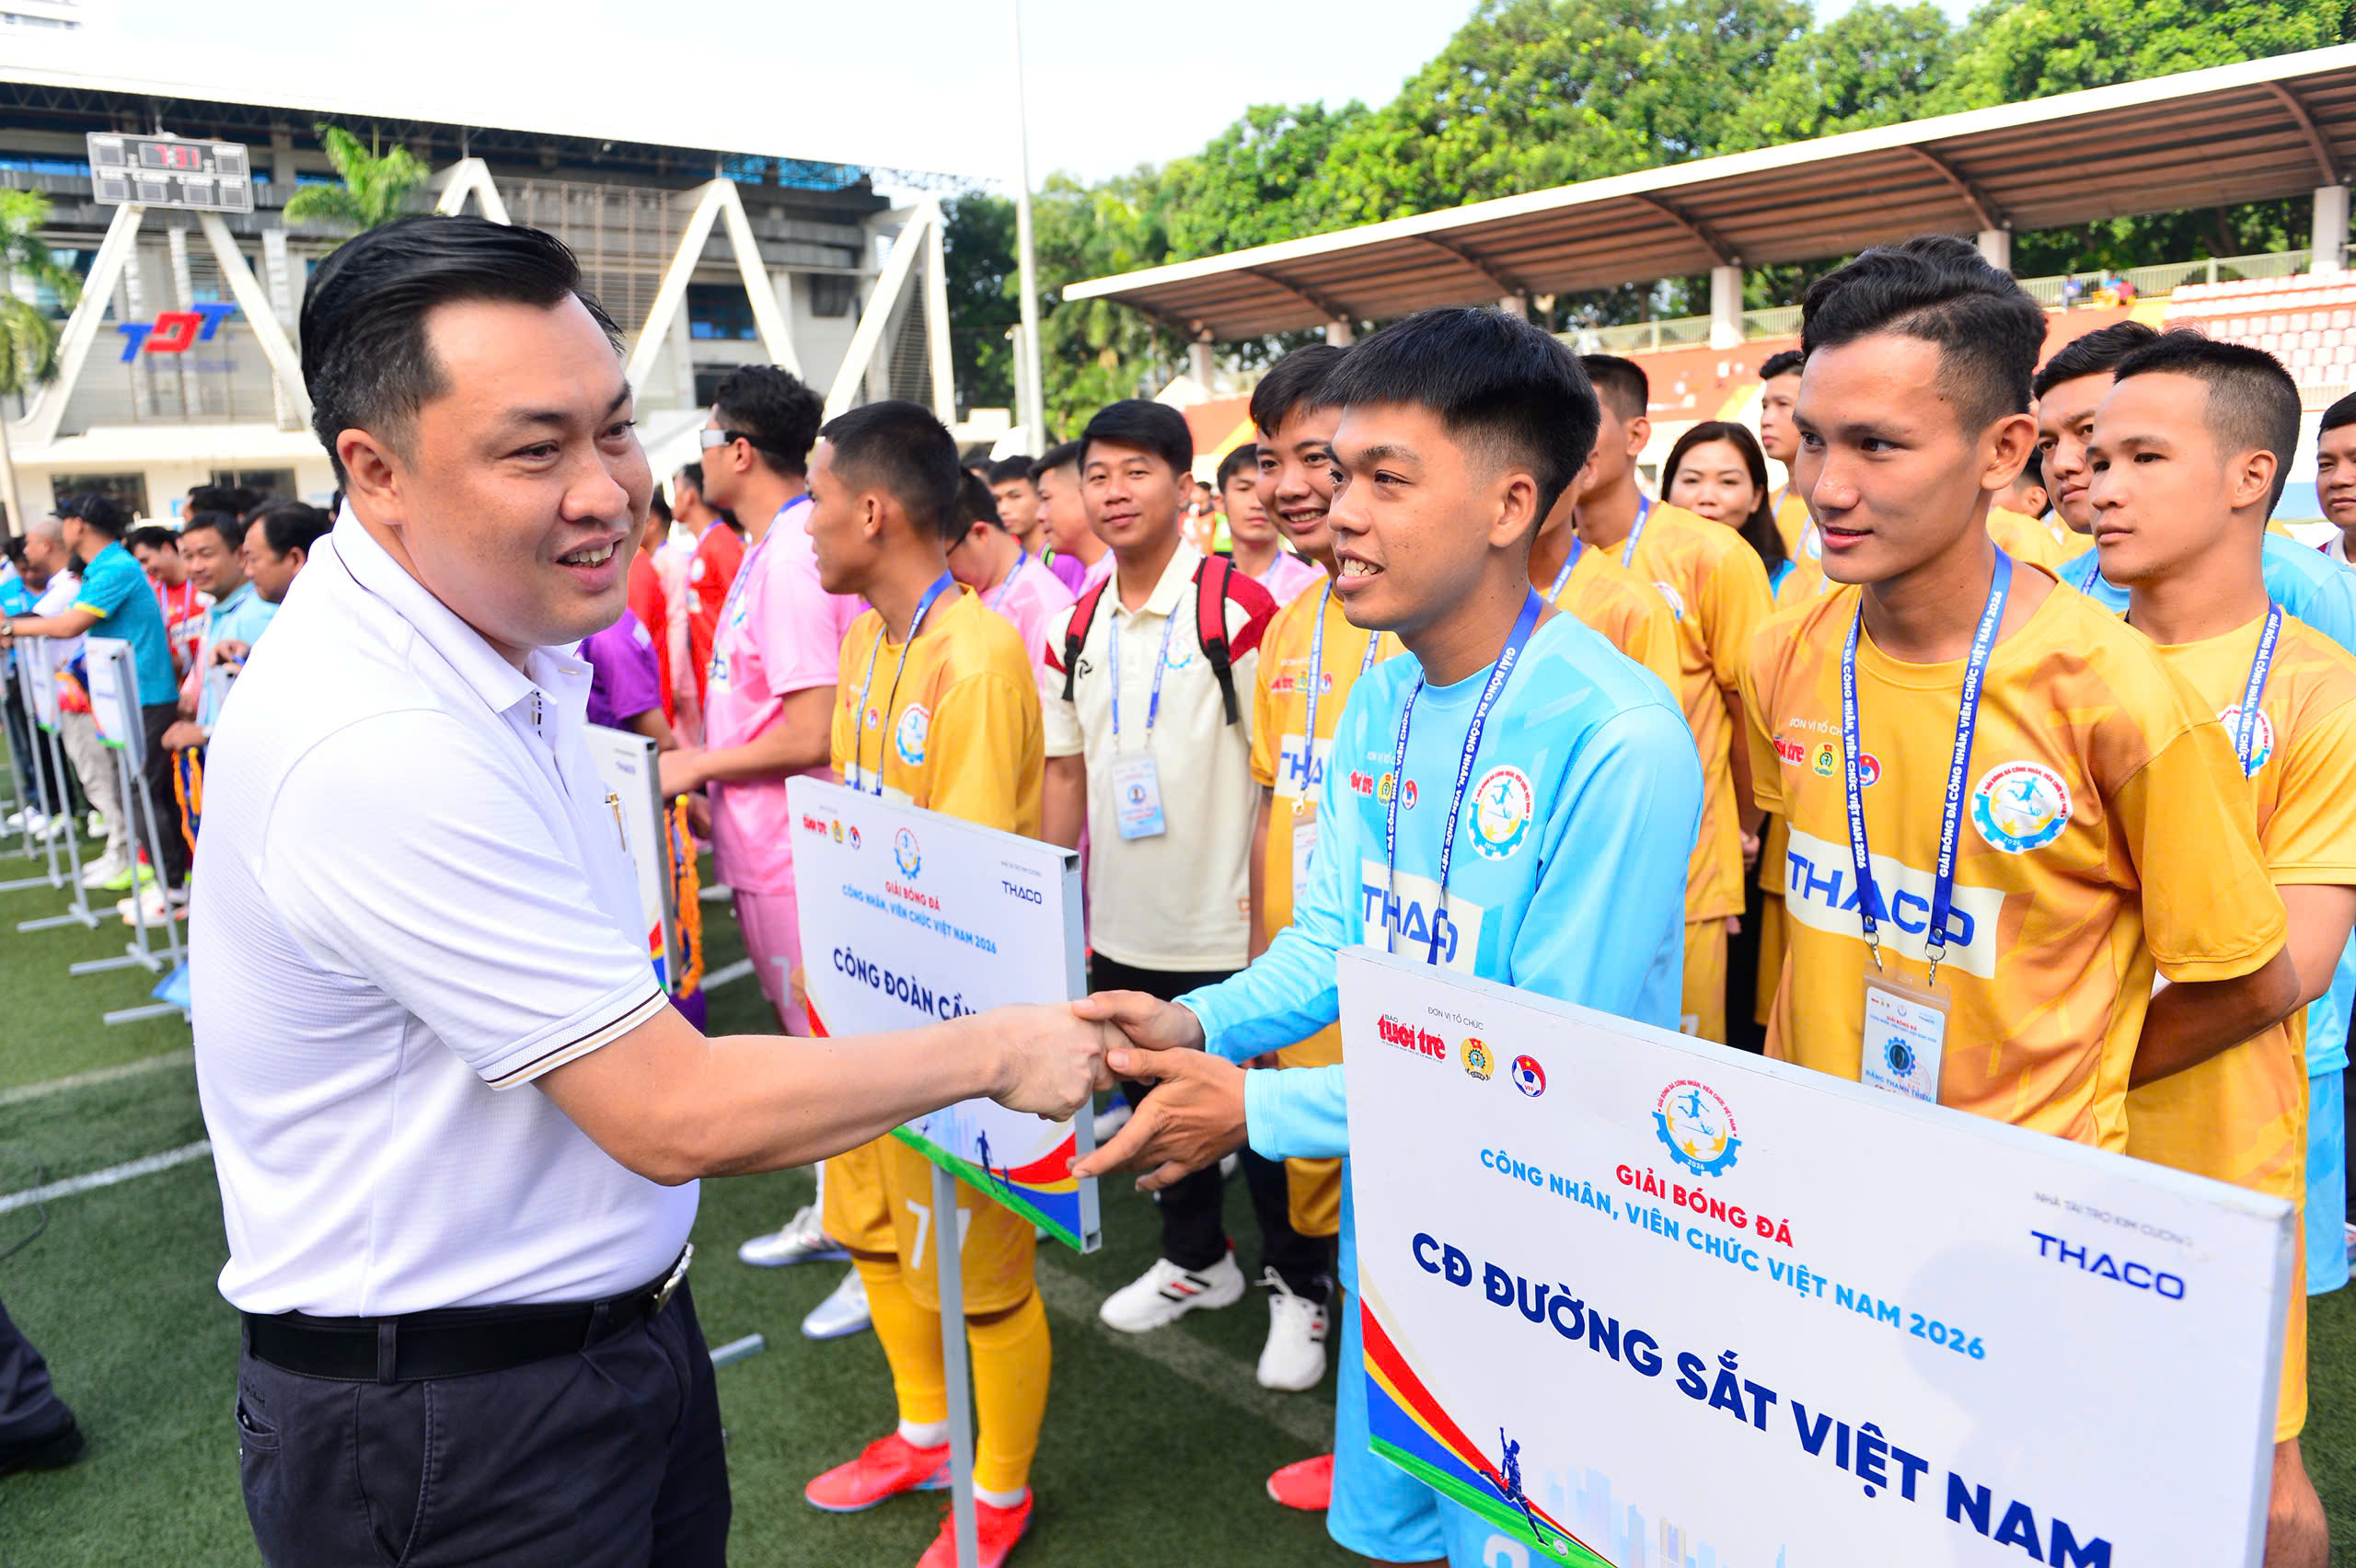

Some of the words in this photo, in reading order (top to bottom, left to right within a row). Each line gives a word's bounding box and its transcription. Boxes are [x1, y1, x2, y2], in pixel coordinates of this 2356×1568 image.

[1986, 590, 2004, 618] 2026
[1978, 617, 1994, 644] NAM
[1970, 641, 1987, 668] VIỆT
[1484, 670, 1506, 702] BÓNG
[1842, 665, 1854, 698] CÔNG
[1964, 667, 1981, 702] CHỨC
[1959, 702, 1973, 728] VIÊN
[1465, 719, 1481, 753] CÔNG
[1845, 733, 1858, 759] VIÊN
[1847, 760, 1859, 792] CHỨC
[1947, 766, 1963, 801] CÔNG
[1848, 792, 1862, 817] VIỆT
[1852, 816, 1865, 843] NAM
[1942, 820, 1956, 853] BÓNG
[1854, 842, 1867, 869] 2026
[1938, 854, 1950, 878] GIẢI
[1001, 881, 1043, 905] THACO
[953, 927, 973, 946] NAM
[834, 947, 880, 989] CÔNG
[884, 970, 933, 1016] ĐOÀN
[1615, 1163, 1666, 1200] GIẢI
[1672, 1187, 1748, 1230] BÓNG
[1755, 1213, 1795, 1249] ĐÁ
[1480, 1147, 1543, 1187] CÔNG
[1549, 1176, 1620, 1222] NHÂN,
[1625, 1202, 1680, 1242] VIÊN
[1686, 1228, 1760, 1273] CHỨC
[1767, 1257, 1828, 1299] VIỆT
[1835, 1285, 1901, 1329] NAM
[1910, 1313, 1986, 1362] 2026
[2030, 1229, 2185, 1300] THACO
[1412, 1232, 1473, 1287] CĐ
[1483, 1262, 1663, 1378] ĐƯỜNG
[1675, 1349, 1777, 1432] SẮT
[1790, 1399, 1930, 1500] VIỆT
[1946, 1470, 2114, 1568] NAM
